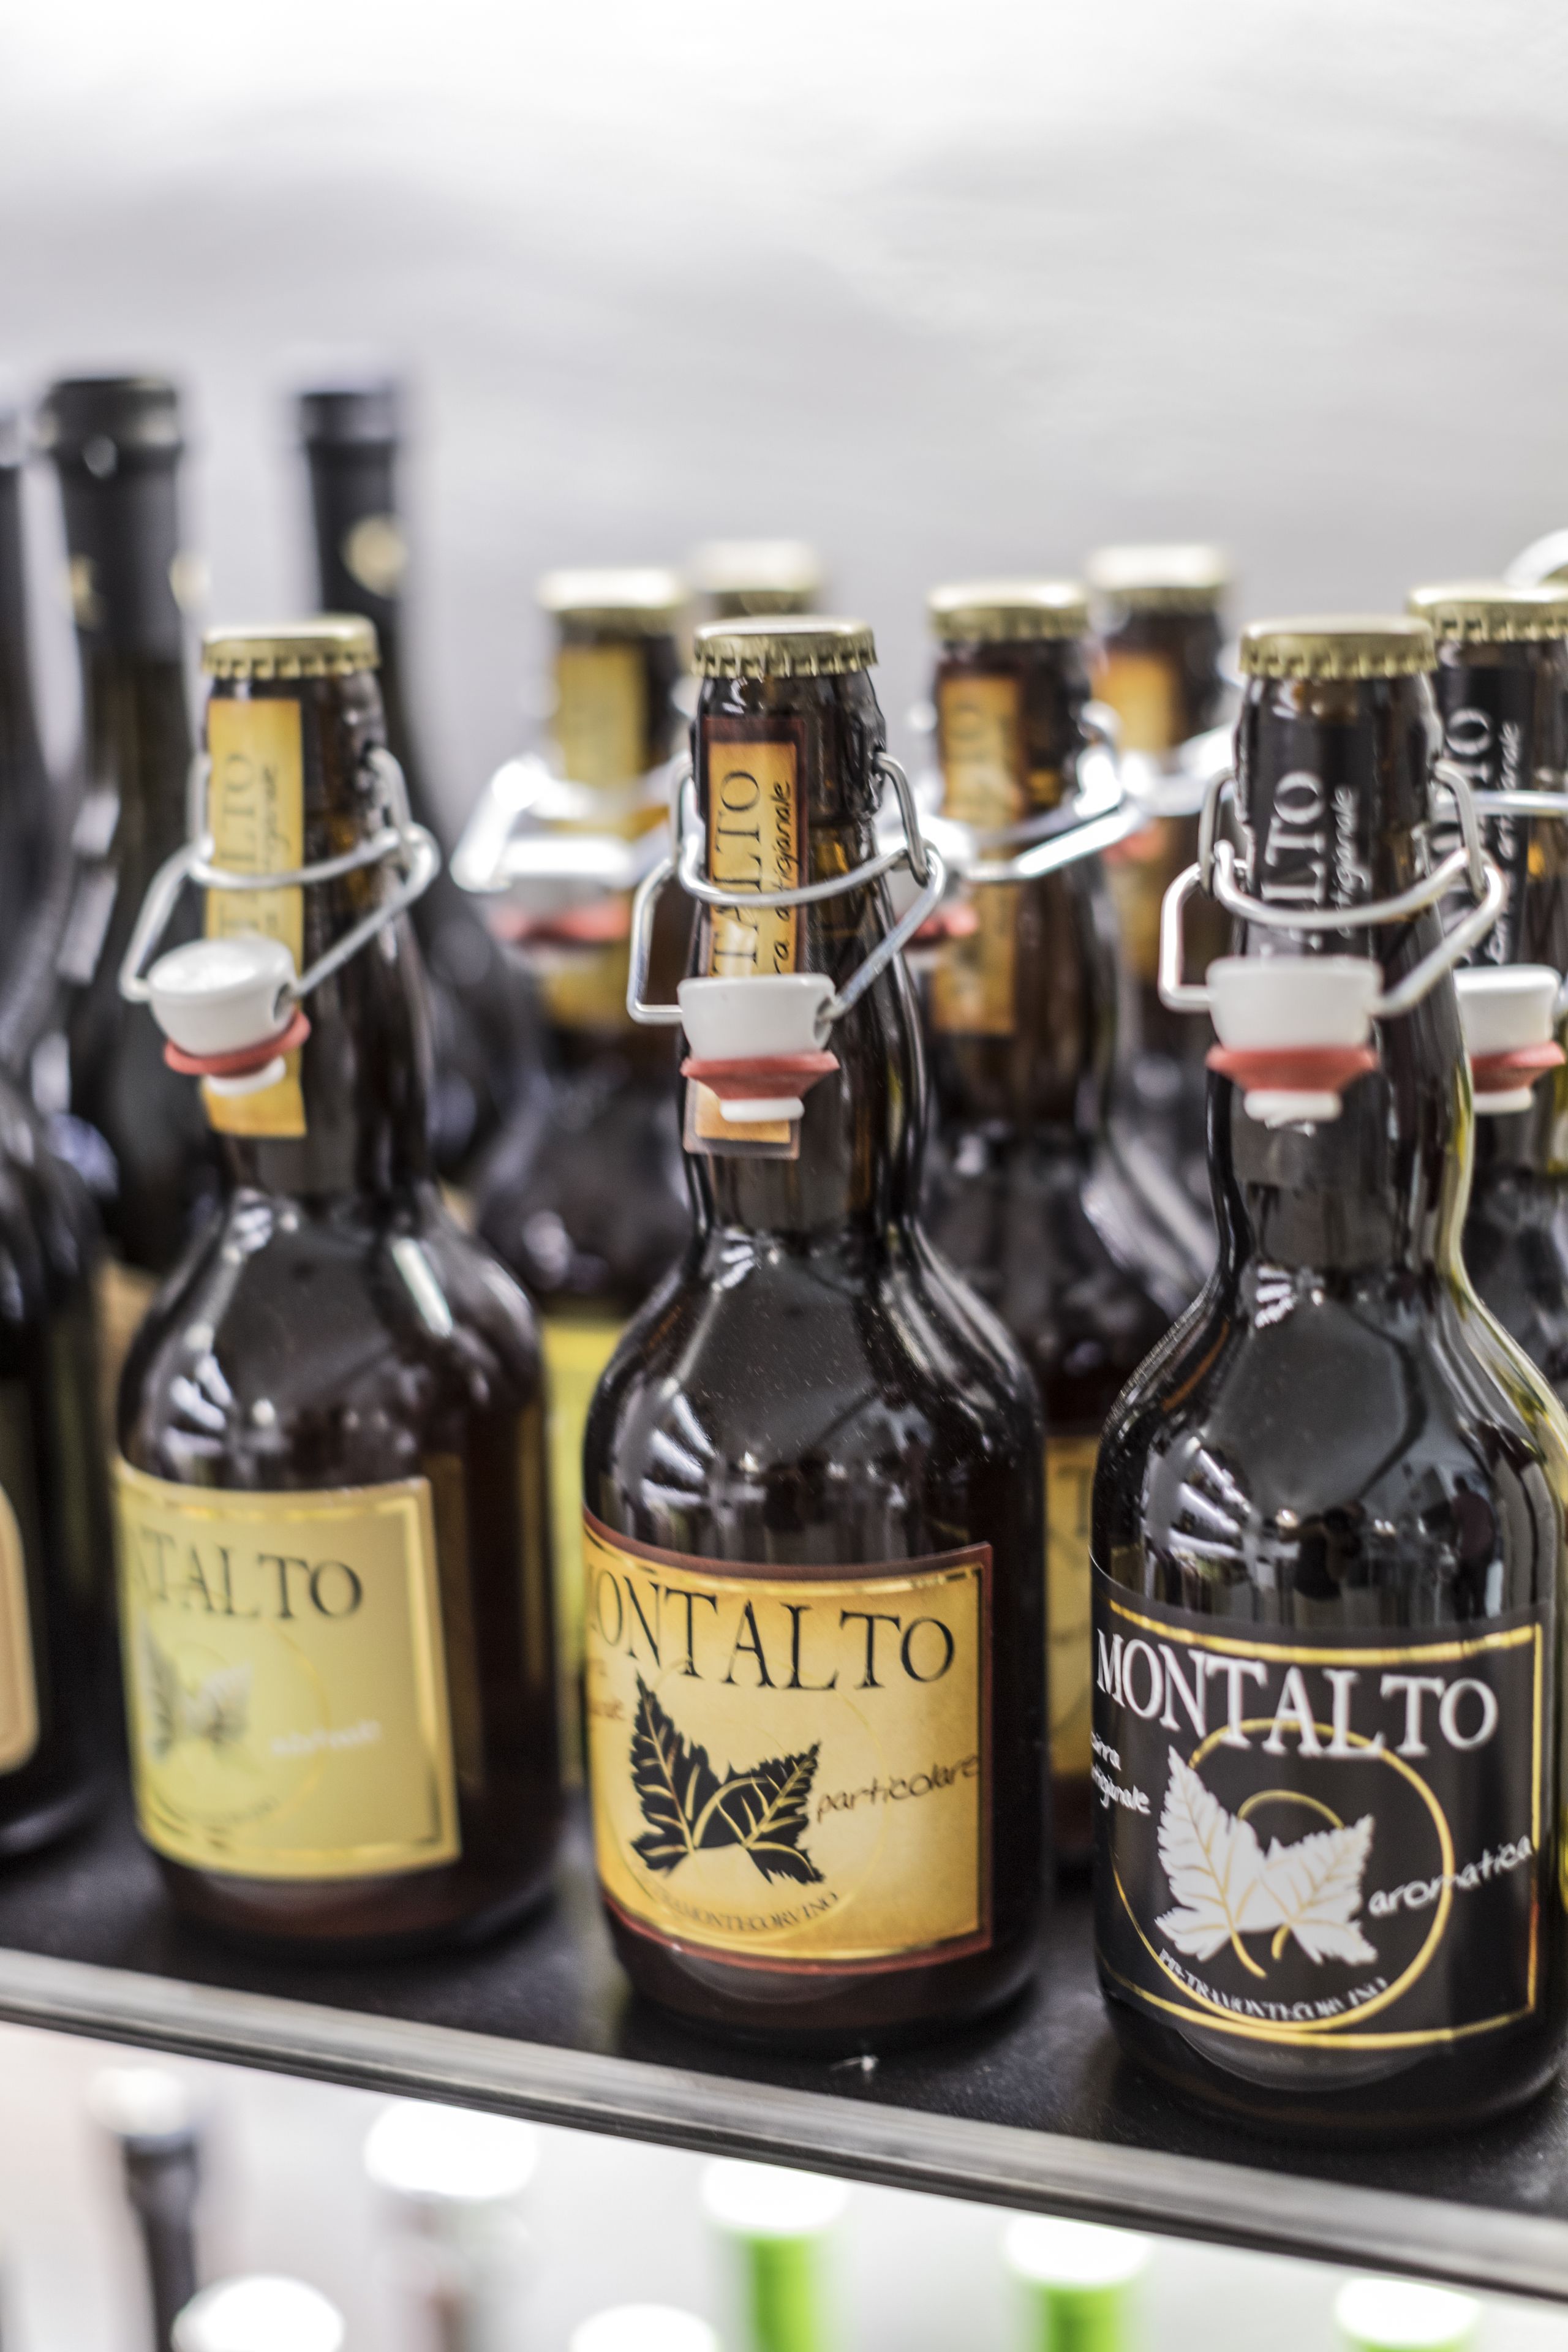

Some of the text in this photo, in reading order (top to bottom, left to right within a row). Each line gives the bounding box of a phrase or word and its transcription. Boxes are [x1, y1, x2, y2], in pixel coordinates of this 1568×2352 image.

[1096, 1627, 1498, 1758] MONTALTO
[816, 1753, 980, 1824] particolare
[1368, 1835, 1532, 1918] aromatica
